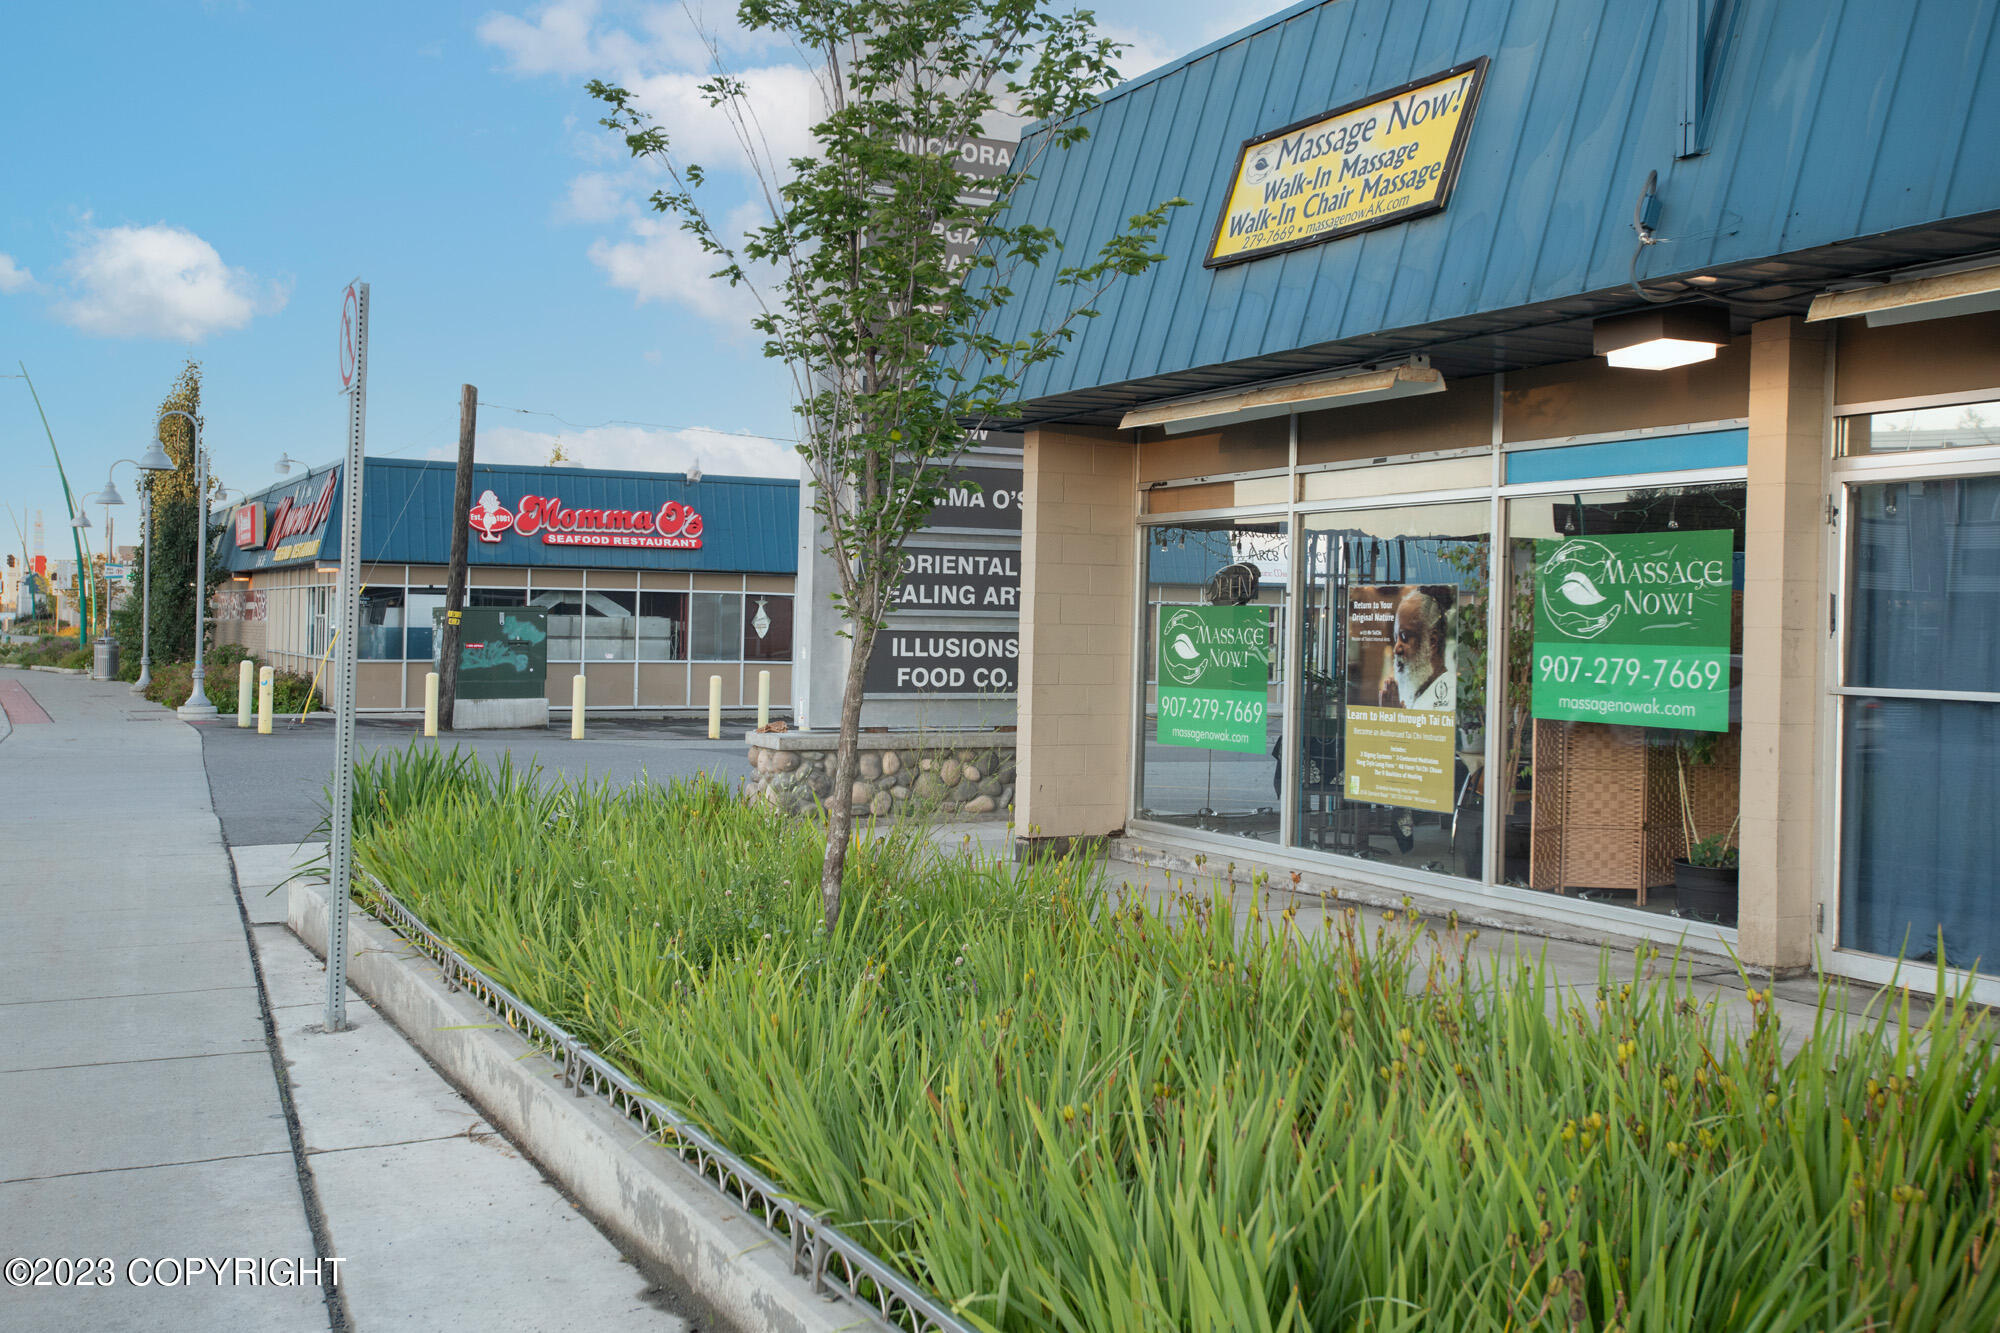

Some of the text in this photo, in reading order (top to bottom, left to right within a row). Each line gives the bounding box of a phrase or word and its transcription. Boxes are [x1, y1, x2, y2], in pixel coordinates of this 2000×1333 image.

[1275, 76, 1468, 171] Massage Now!
[1264, 140, 1419, 204] Walk-In Massage
[1229, 161, 1442, 238] Walk-In Chair Massage
[1241, 194, 1410, 250] 279-7669 massagenowAK.com
[514, 495, 703, 538] Momma O's
[548, 534, 697, 547] SEAFOOD RESTAURANT
[901, 554, 1018, 576] ORIENTAL
[1600, 559, 1723, 590] MASSAGE
[880, 583, 976, 605] EALING
[1624, 590, 1694, 616] NOW!
[1375, 613, 1394, 622] Nature
[892, 637, 1019, 658] ILLUSIONS
[1196, 625, 1264, 648] MASSAGE
[1210, 648, 1249, 668] NOW!
[897, 667, 1013, 687] FOOD CO.
[1539, 655, 1721, 690] 907-279-7669
[1161, 696, 1263, 724] 907-279-7669
[1558, 697, 1696, 717] massagenowak.com
[1347, 709, 1454, 728] Learn to Heal through Tai Chi
[1172, 727, 1249, 743] massagenowak.com
